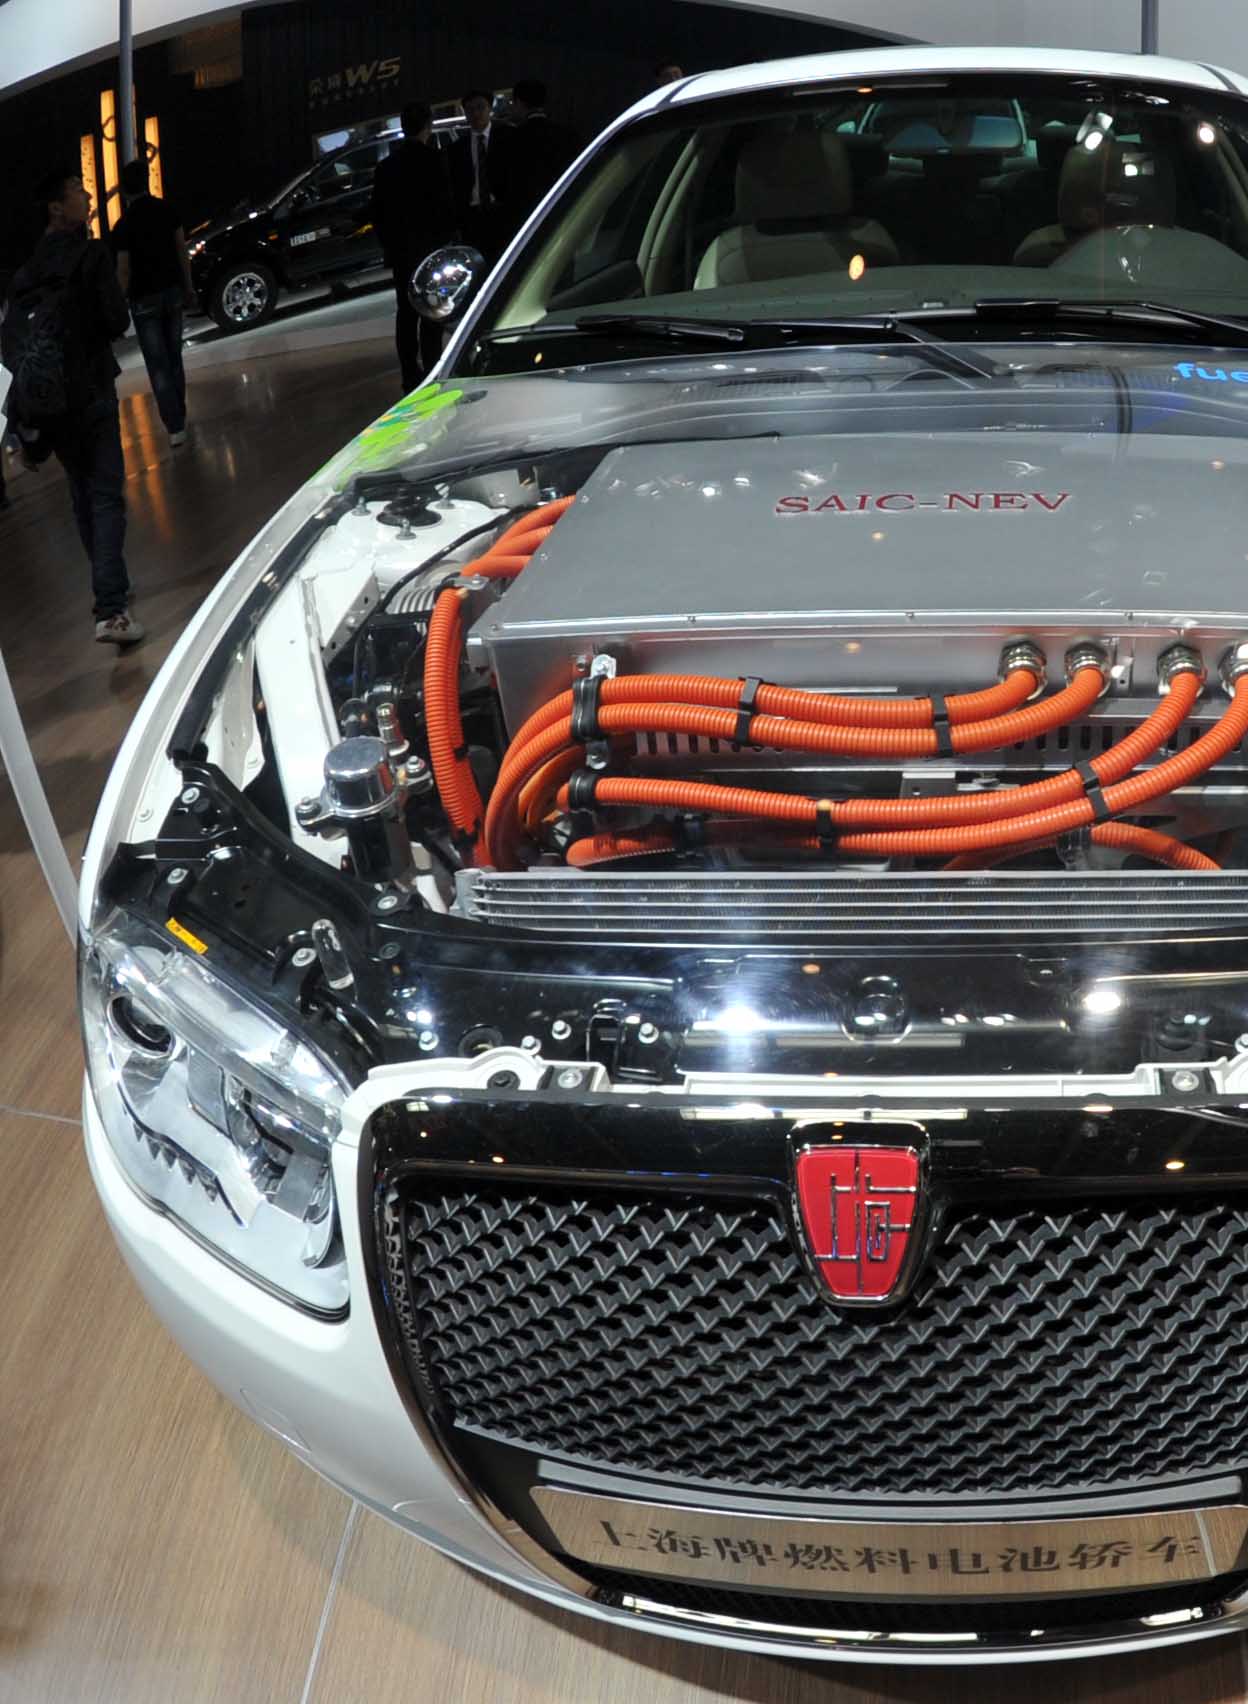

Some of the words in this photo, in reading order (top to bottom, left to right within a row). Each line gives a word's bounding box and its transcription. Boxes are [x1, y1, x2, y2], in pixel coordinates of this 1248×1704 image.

[774, 492, 1071, 514] SAIC-NEV
[600, 1520, 1200, 1575] 上海牌燃料电池轿车
